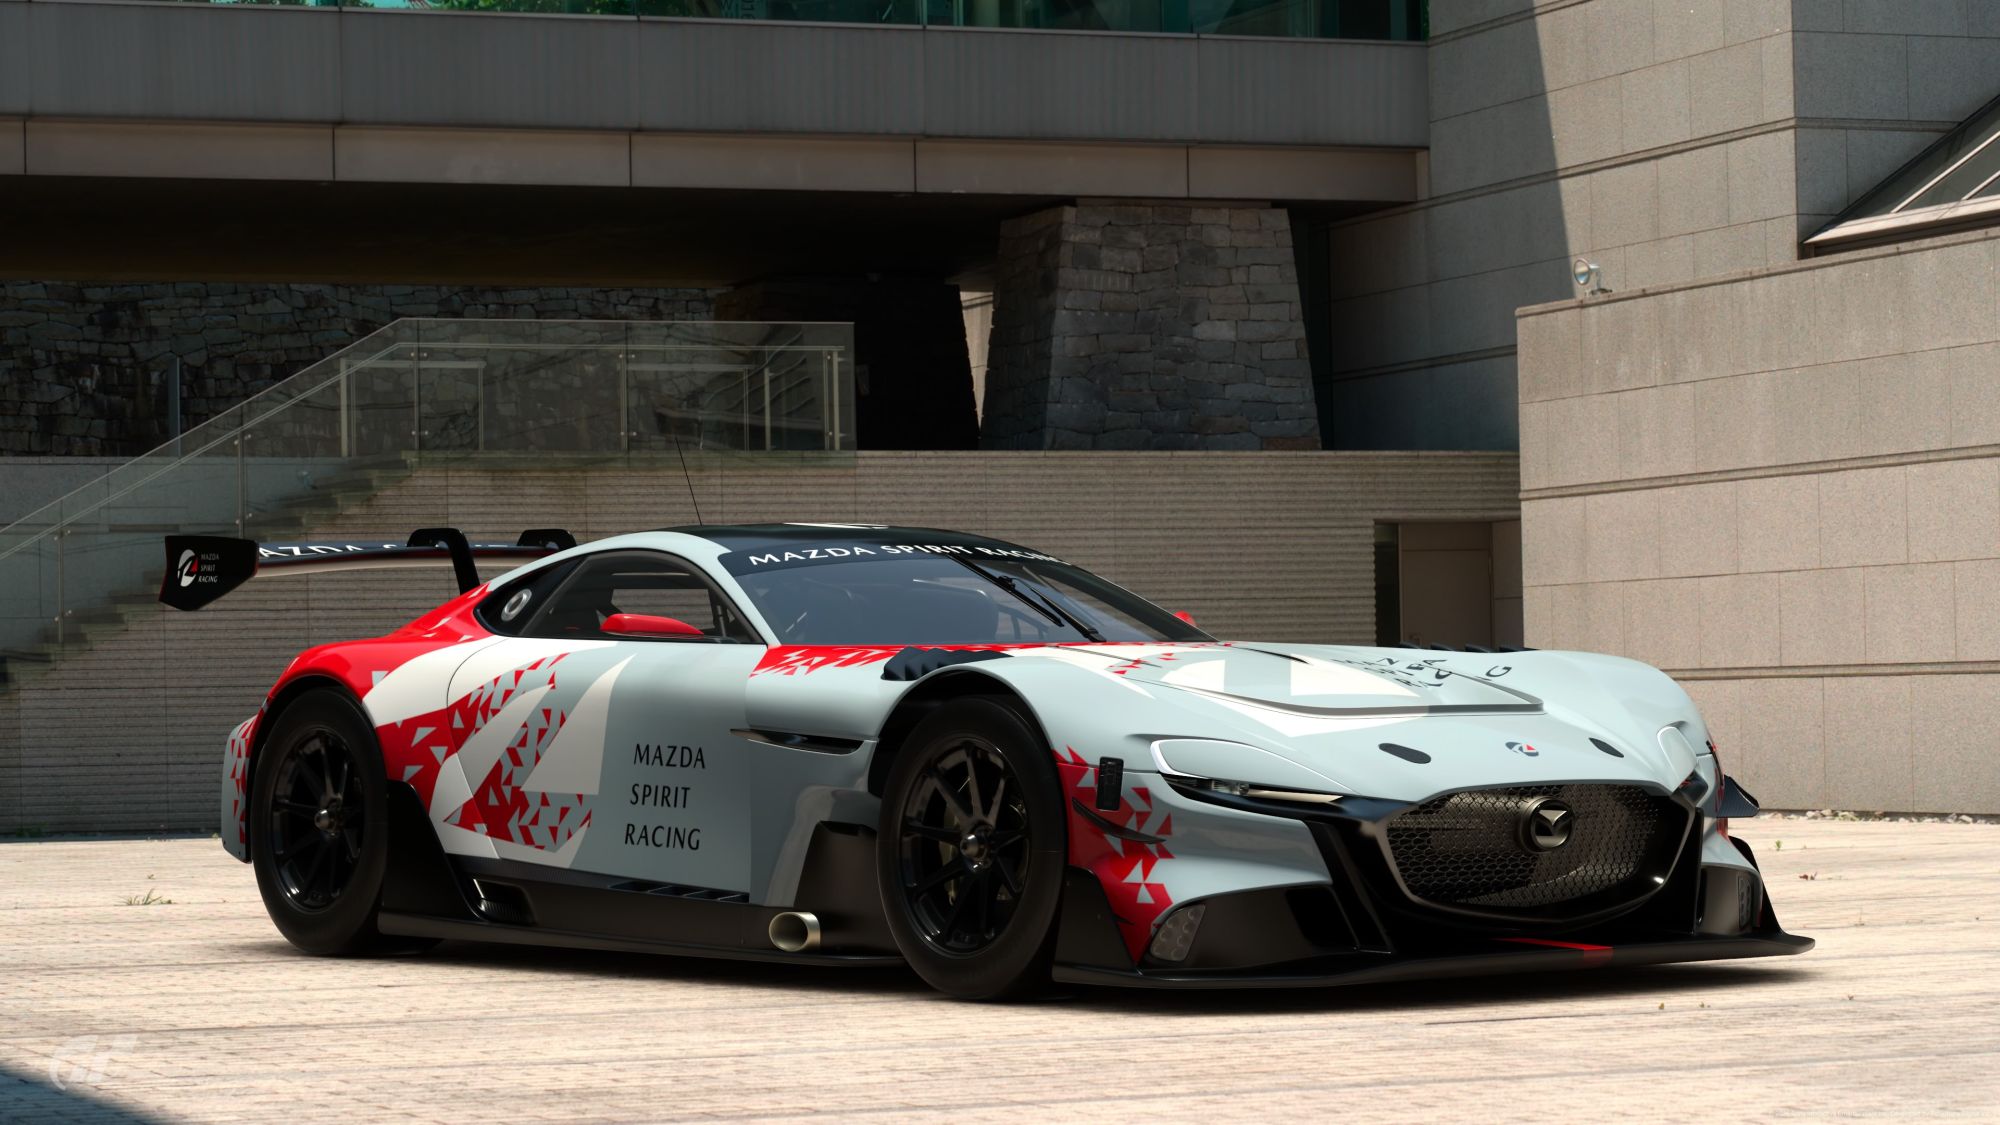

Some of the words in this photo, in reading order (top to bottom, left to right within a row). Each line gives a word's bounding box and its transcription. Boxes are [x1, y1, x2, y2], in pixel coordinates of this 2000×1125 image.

[201, 553, 220, 561] MAZDA
[748, 546, 877, 566] MAZDA
[880, 544, 973, 556] SPIRIT
[198, 575, 219, 583] RACING
[200, 564, 216, 572] SPIRIT
[633, 743, 706, 769] MAZDA
[630, 783, 691, 809] SPIRIT
[624, 823, 701, 851] RACING
